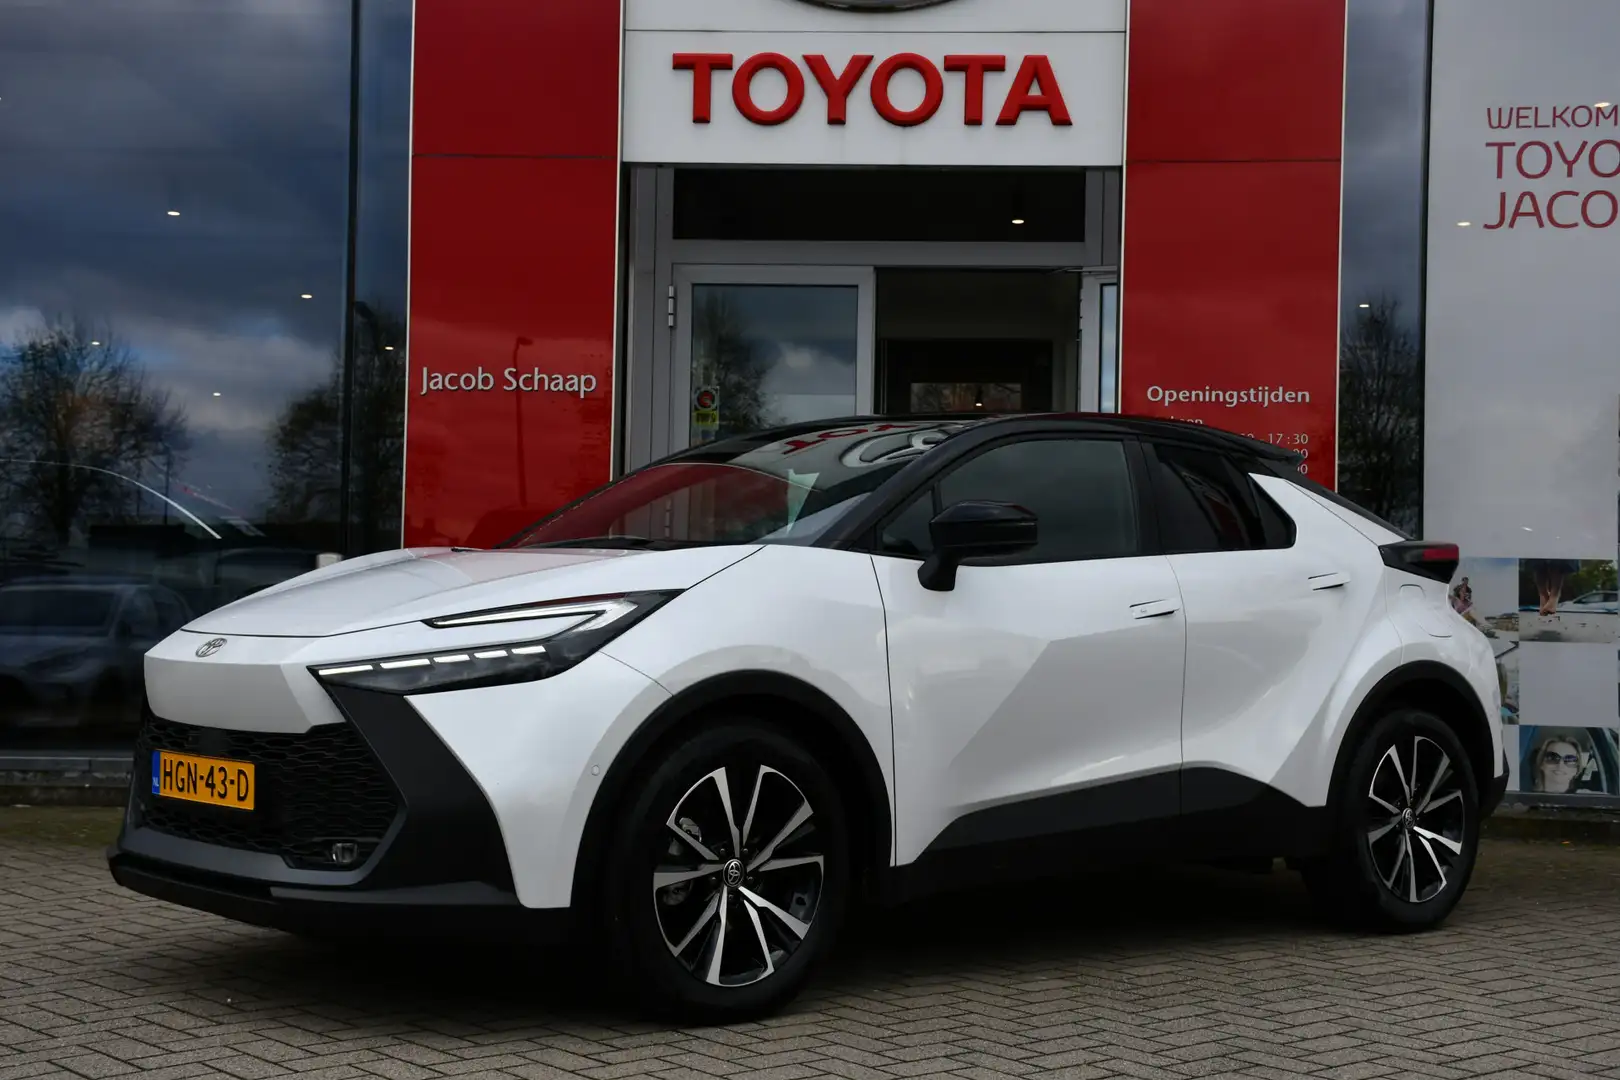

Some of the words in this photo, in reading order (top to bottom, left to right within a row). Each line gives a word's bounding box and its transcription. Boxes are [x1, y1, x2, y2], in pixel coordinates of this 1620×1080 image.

[672, 52, 1073, 127] TOYOTA
[1486, 105, 1619, 129] WELKOM
[1485, 139, 1620, 179] TOYO
[1483, 190, 1619, 229] JACO
[420, 366, 495, 395] Jacob
[503, 367, 597, 399] Schaap
[1147, 385, 1310, 408] Openingstijden
[163, 758, 249, 802] HGN-43-D
